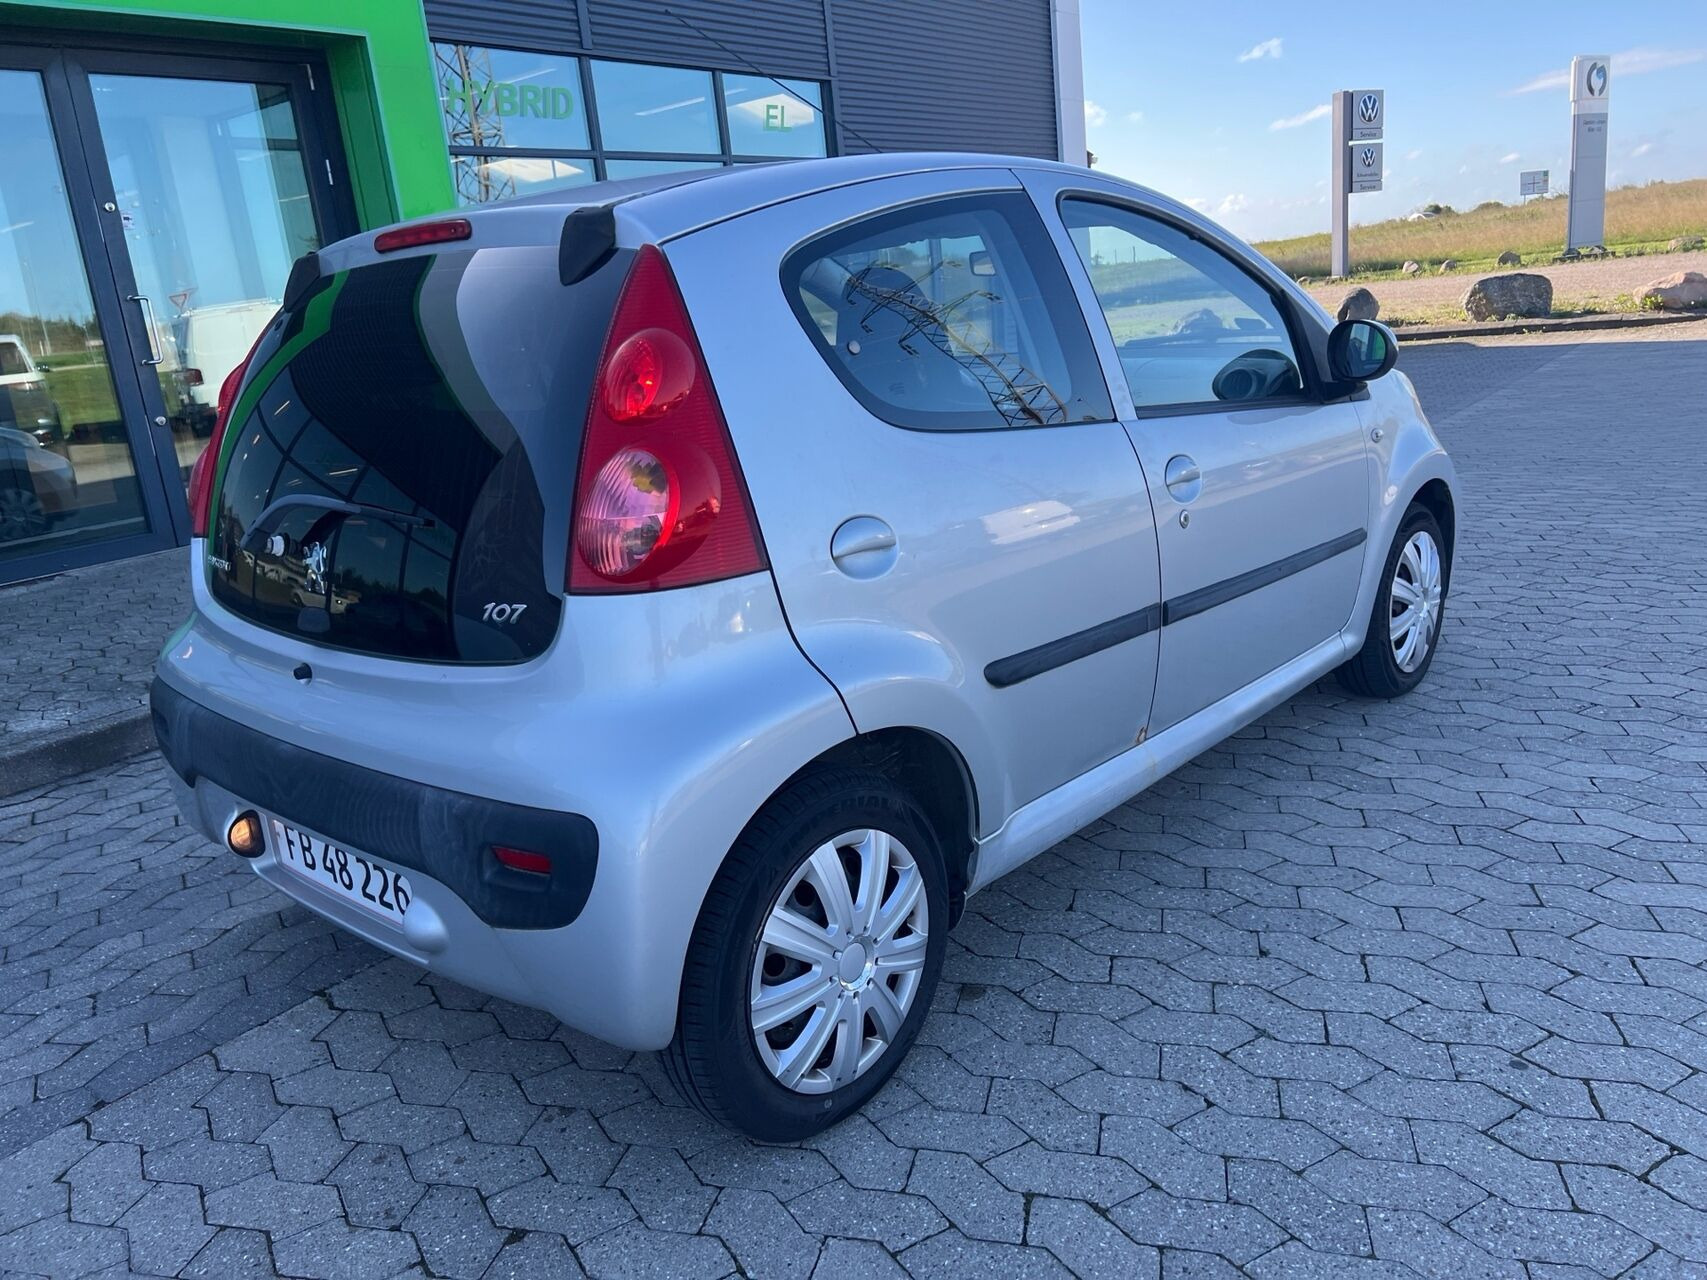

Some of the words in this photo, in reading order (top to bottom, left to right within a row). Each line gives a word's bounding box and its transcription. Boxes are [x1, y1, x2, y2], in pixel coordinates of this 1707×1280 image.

[447, 77, 575, 121] HYBRID
[764, 104, 793, 132] EL
[483, 602, 528, 624] 107
[284, 825, 317, 871] FB
[322, 843, 355, 891] 48
[355, 857, 412, 916] 226
